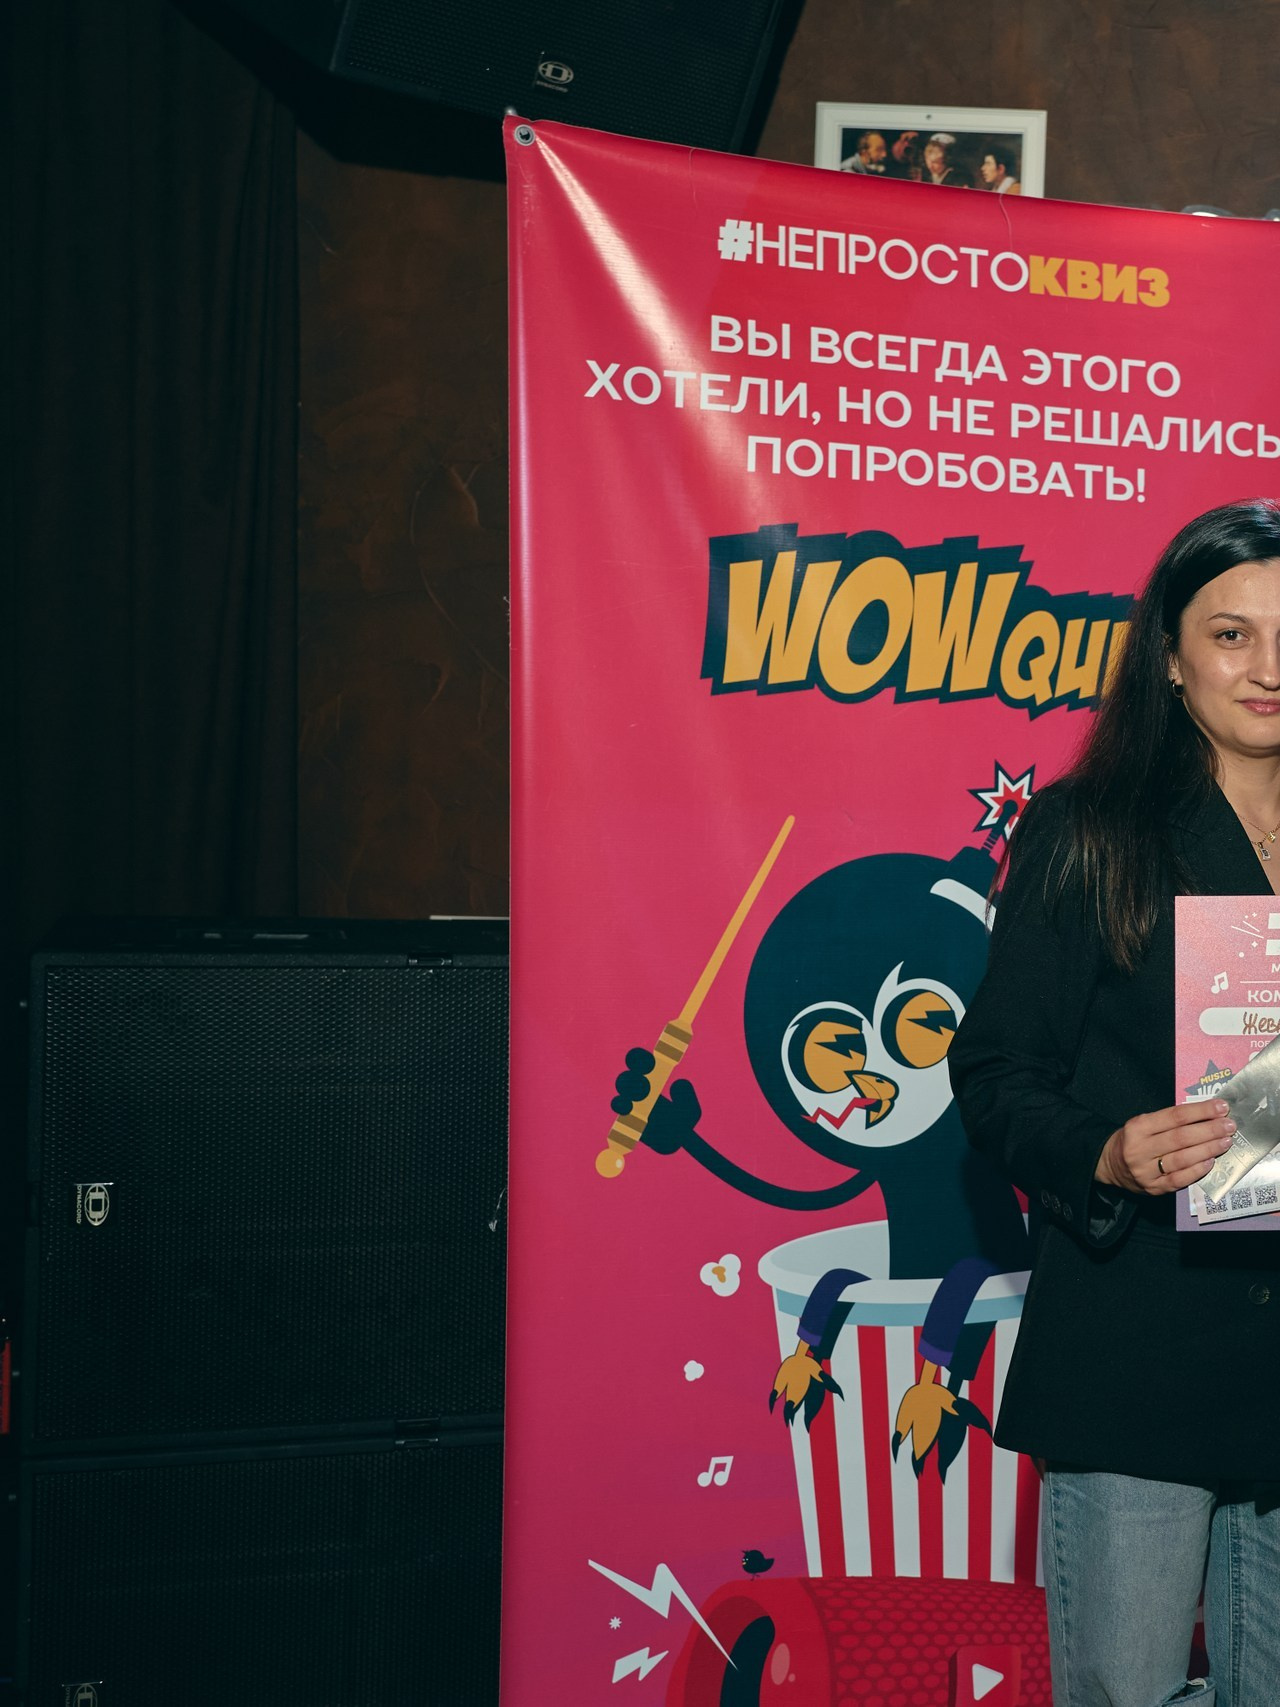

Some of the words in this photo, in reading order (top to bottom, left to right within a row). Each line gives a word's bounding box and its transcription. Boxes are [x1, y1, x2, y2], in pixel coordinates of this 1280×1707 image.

[717, 218, 1171, 308] #НЕПРОСТОКВИЗ
[710, 314, 791, 359] ВЫ
[809, 326, 1008, 384] ВСЕГДА
[1022, 348, 1181, 397] ЭТОГО
[584, 359, 821, 423] ХОТЕЛИ,
[837, 387, 911, 427] НО
[929, 396, 992, 437] НЕ
[746, 434, 1147, 504] ПОПРОБОВАТЬ!
[1199, 1068, 1231, 1085] MUSIC
